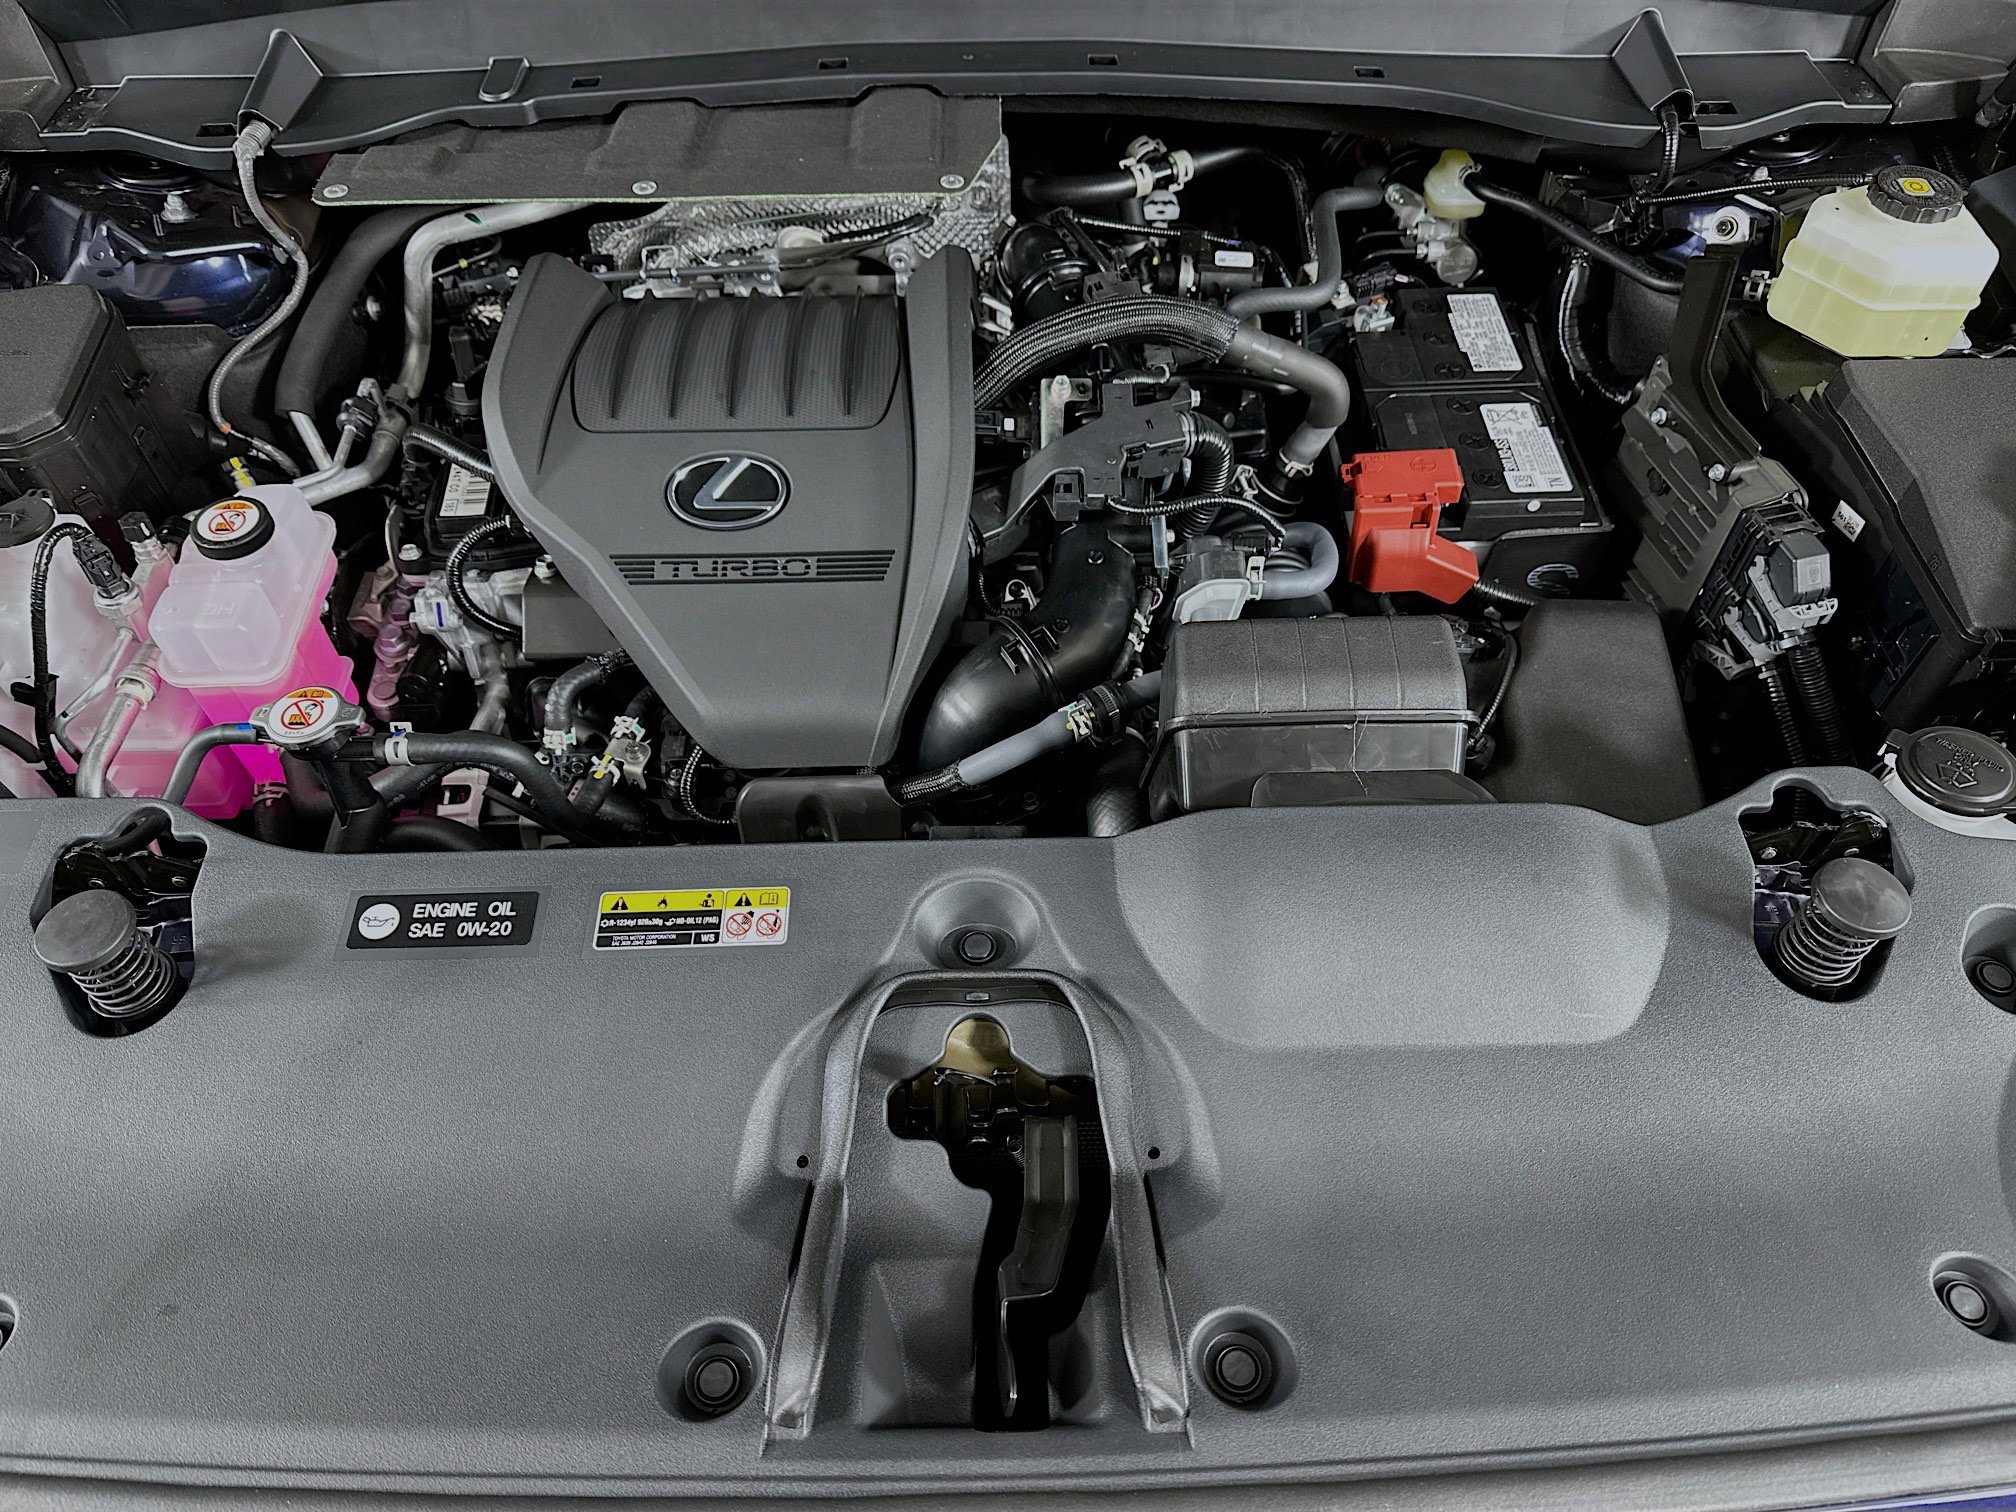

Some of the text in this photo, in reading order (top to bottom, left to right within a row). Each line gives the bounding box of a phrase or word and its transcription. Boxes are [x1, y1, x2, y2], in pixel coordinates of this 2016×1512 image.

[659, 558, 811, 578] TURBO
[412, 901, 517, 919] ENGINE OIL
[407, 920, 513, 939] SAE 0W-20
[701, 934, 715, 942] WS
